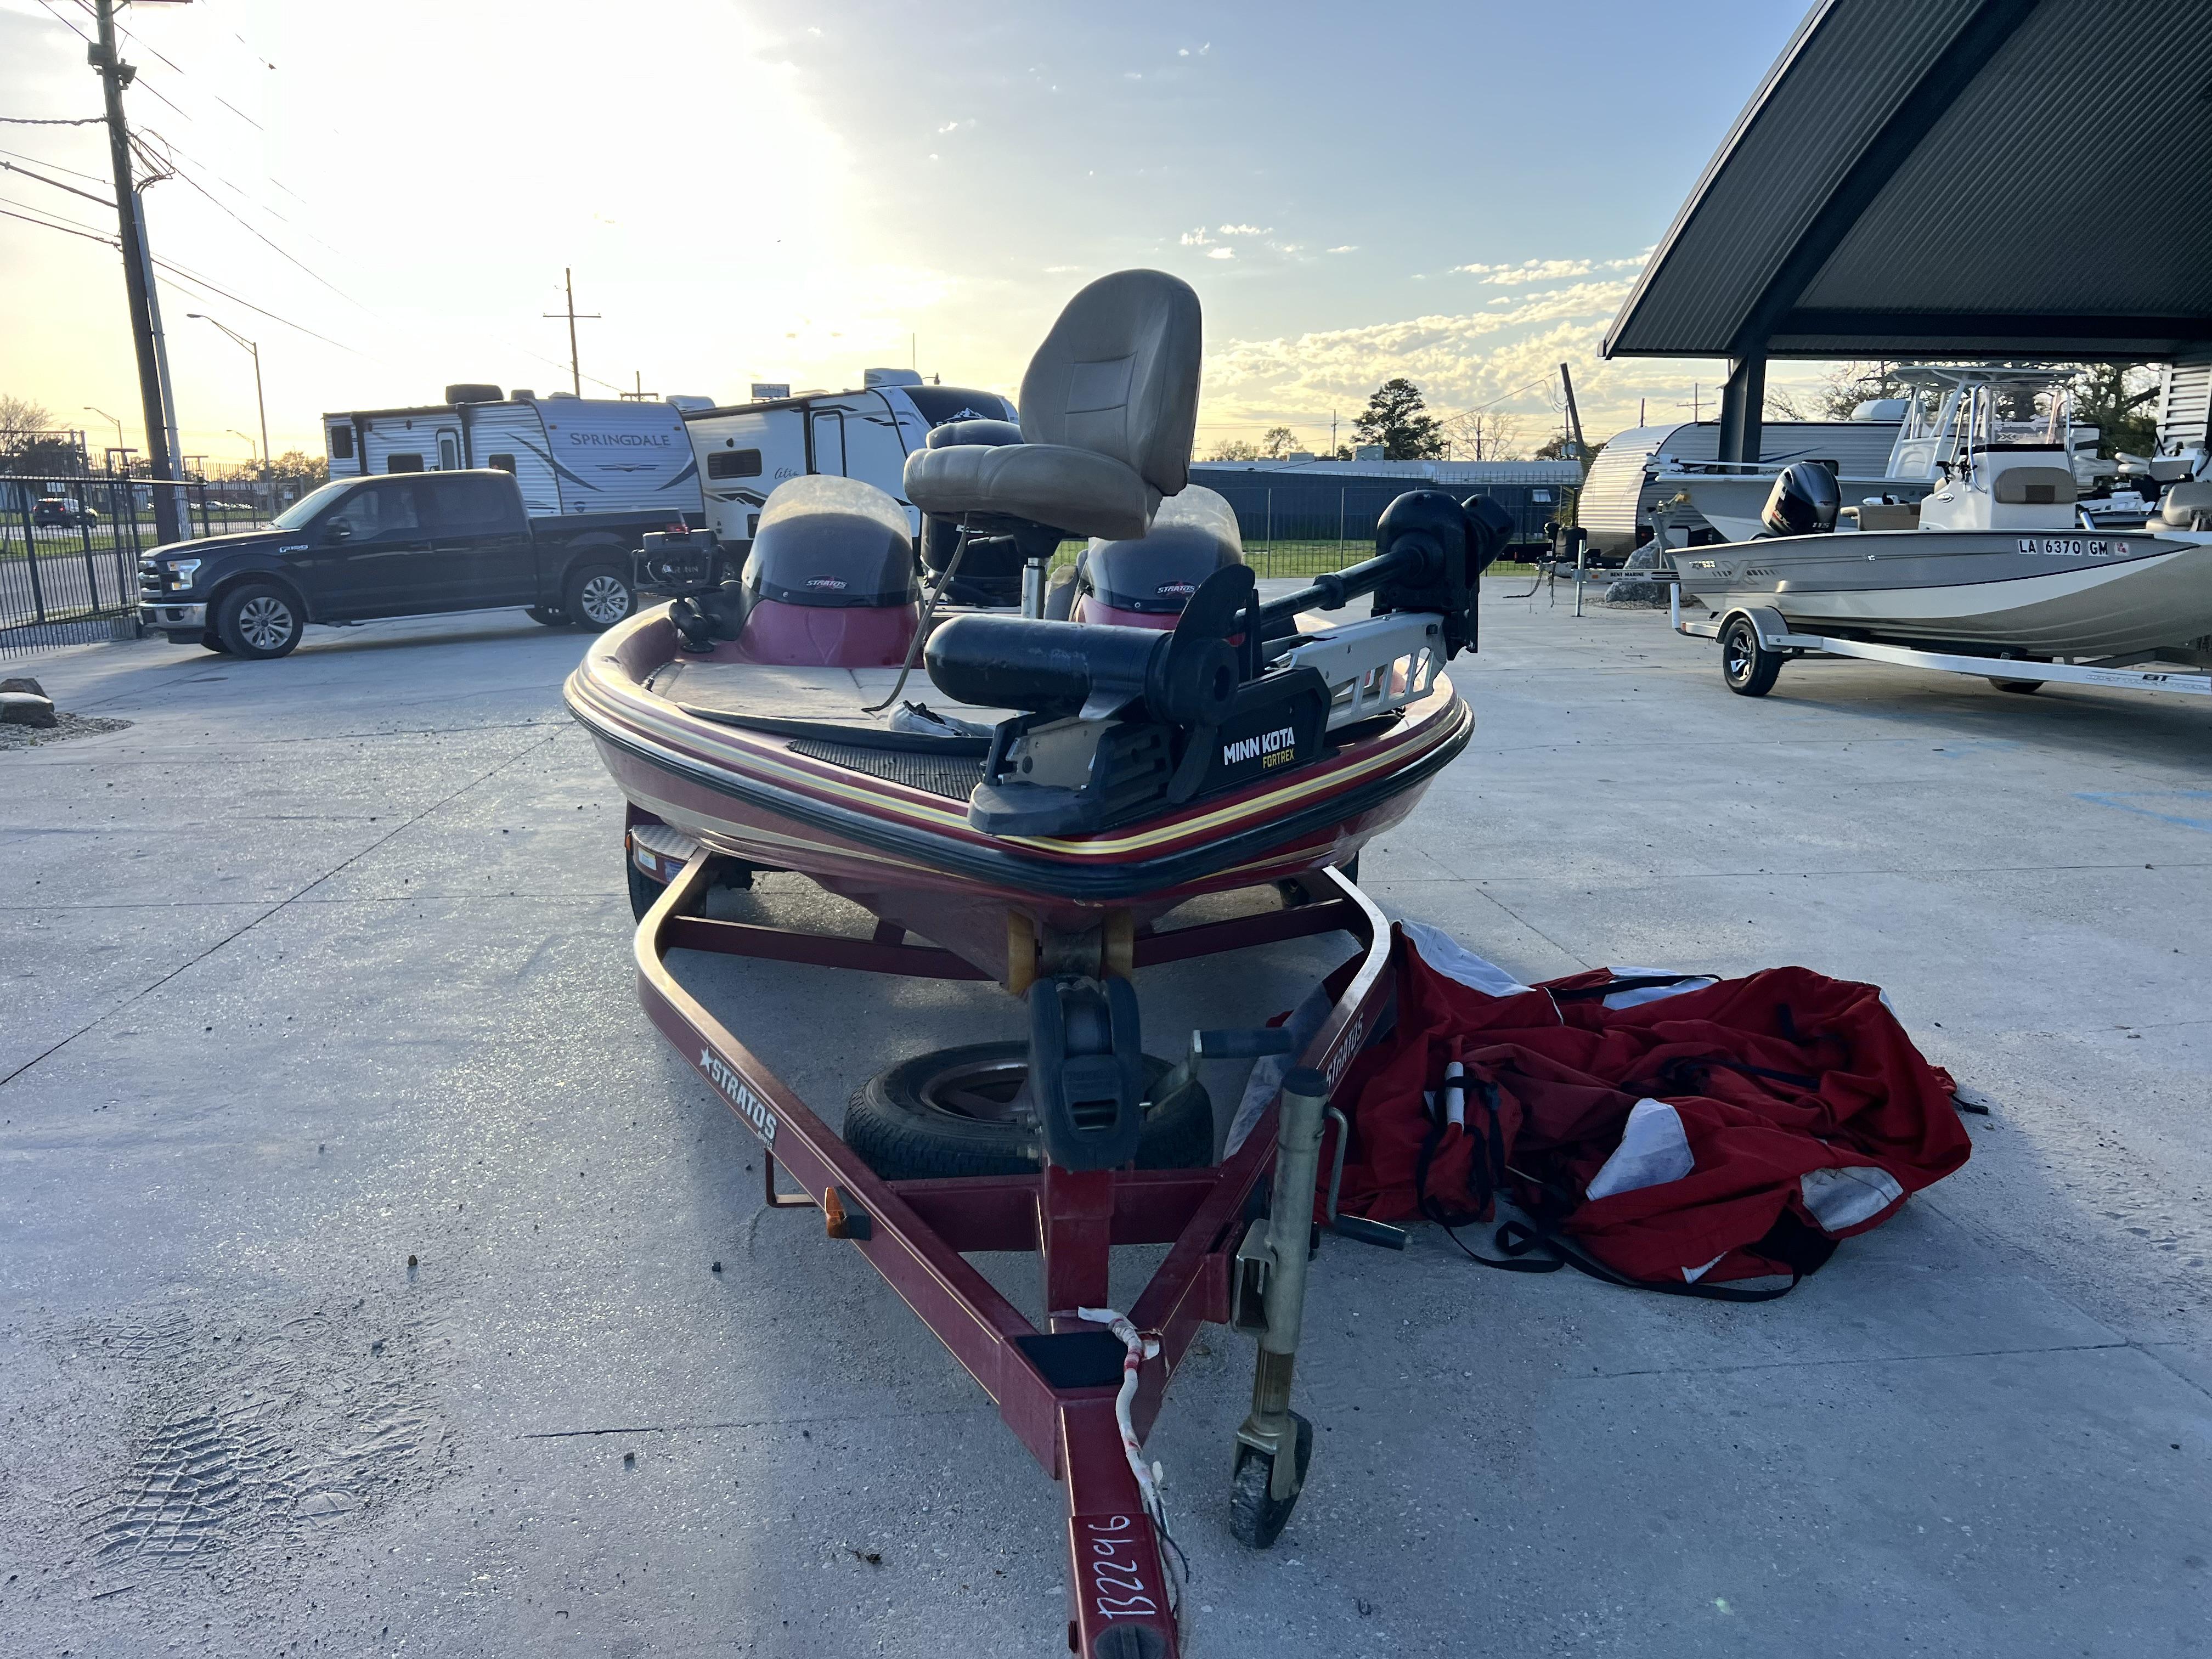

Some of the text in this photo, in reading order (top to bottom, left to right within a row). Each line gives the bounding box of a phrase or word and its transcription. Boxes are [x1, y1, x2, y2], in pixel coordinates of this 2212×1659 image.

[570, 432, 671, 446] SPRINGDALE
[2019, 540, 2036, 553] LA
[2045, 540, 2081, 555] 6370
[2089, 541, 2108, 555] GM
[1157, 585, 1195, 594] STRATOS
[1223, 726, 1295, 766] MINN KOTA
[1262, 748, 1294, 769] FORTREX
[1326, 1012, 1363, 1089] STRATOS
[712, 1058, 777, 1139] STRATOS
[1088, 1515, 1158, 1620] B2296
